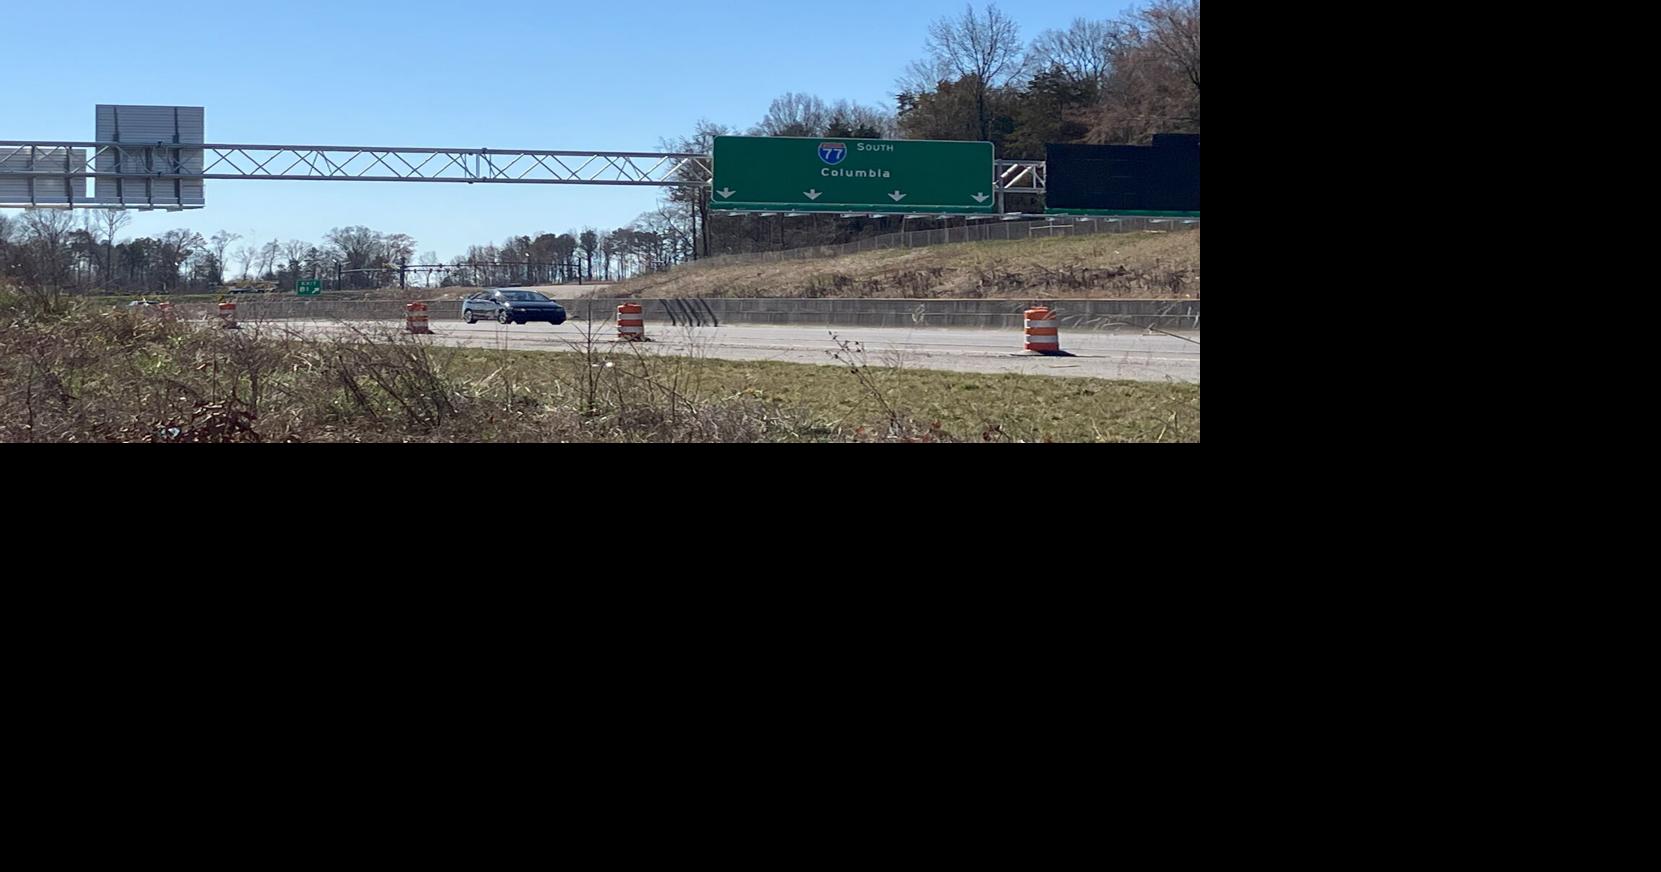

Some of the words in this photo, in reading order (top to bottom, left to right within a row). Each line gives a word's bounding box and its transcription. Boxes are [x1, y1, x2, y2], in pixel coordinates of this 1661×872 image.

[857, 142, 894, 152] SOUTH
[822, 148, 843, 160] 77
[821, 167, 890, 178] Columbia
